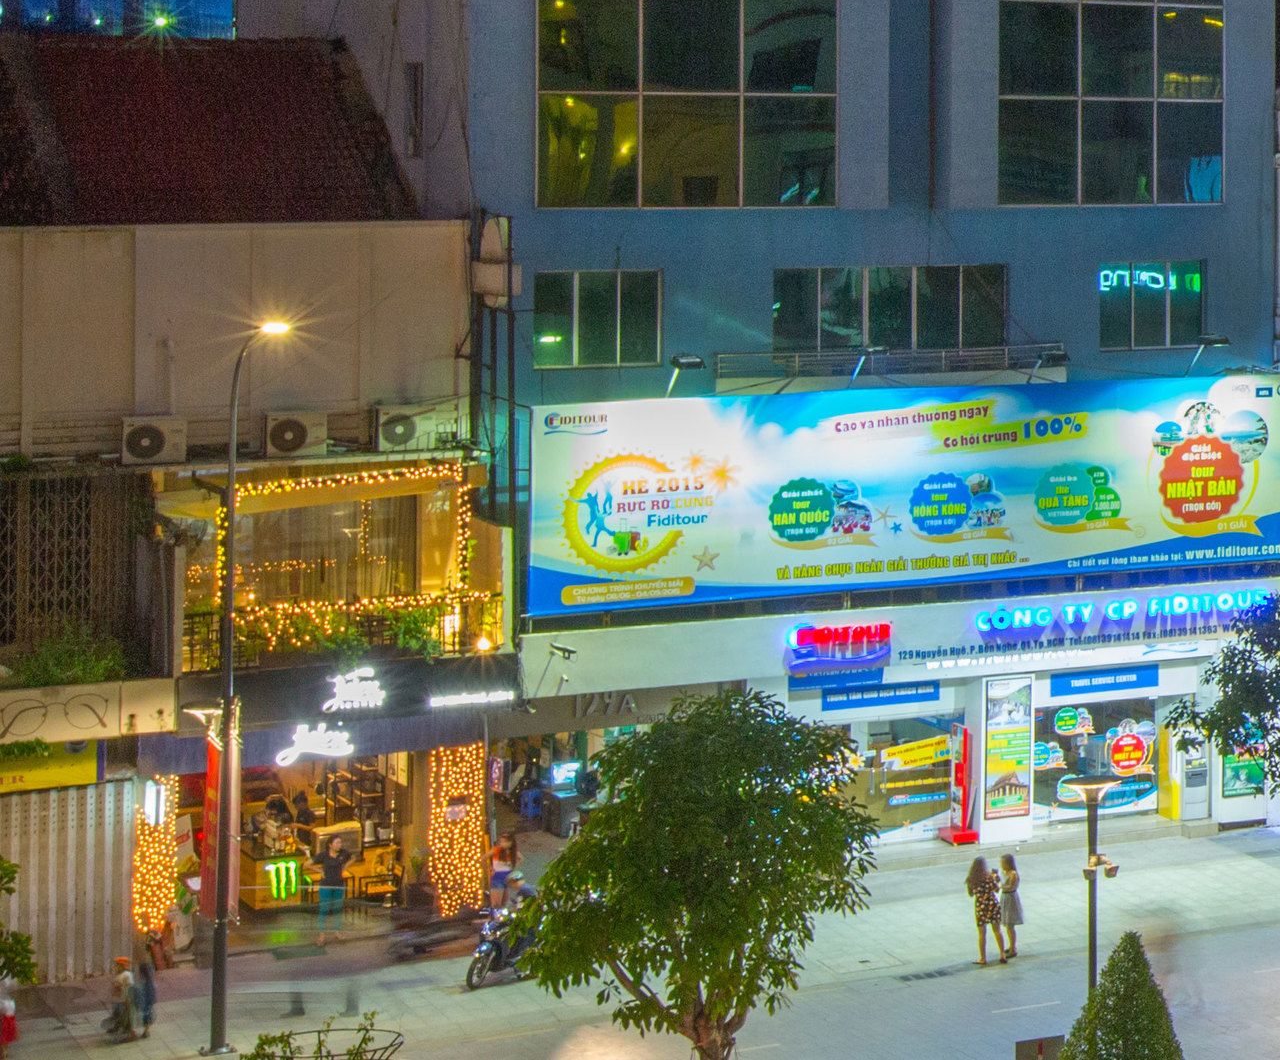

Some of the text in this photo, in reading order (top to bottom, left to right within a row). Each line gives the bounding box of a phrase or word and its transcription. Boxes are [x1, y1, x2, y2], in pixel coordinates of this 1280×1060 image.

[959, 404, 989, 422] ngay
[1023, 415, 1083, 439] 100%
[1190, 466, 1216, 478] tour
[656, 475, 705, 494] 2015
[1166, 475, 1237, 501] NHẬT BẢN
[647, 514, 708, 527] Fiditour
[974, 604, 1052, 632] CÔNG
[1062, 601, 1094, 625] TY
[1105, 598, 1138, 622] CP
